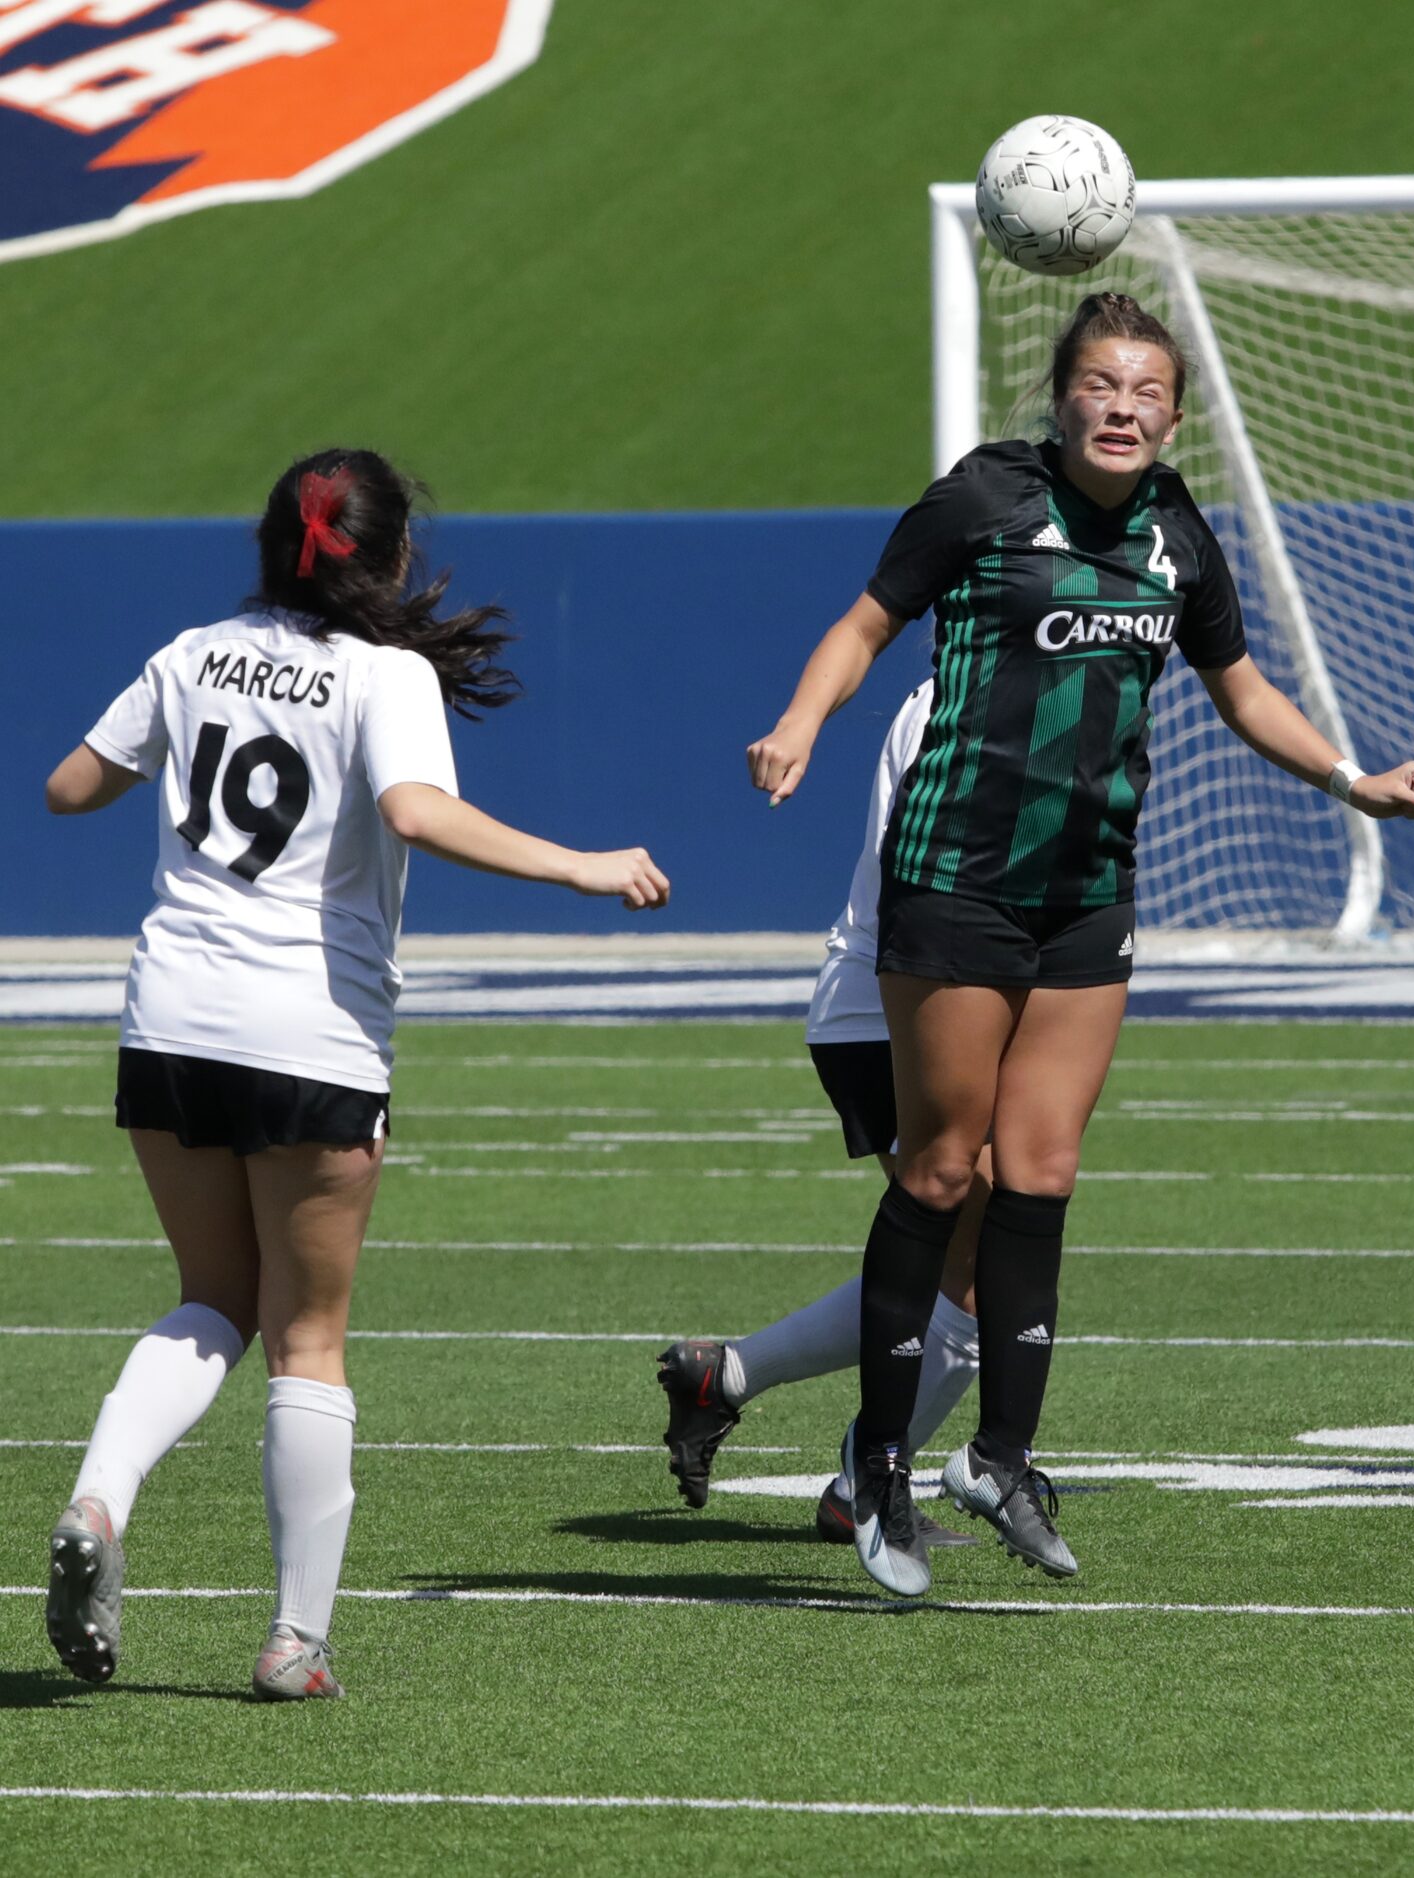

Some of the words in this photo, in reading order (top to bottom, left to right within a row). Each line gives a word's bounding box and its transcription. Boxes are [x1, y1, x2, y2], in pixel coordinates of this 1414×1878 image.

[1032, 538, 1070, 550] adidas
[1147, 525, 1178, 591] 4
[1034, 610, 1176, 650] CARROLL
[197, 651, 335, 708] MARCUS
[176, 721, 311, 884] 19
[891, 1348, 924, 1357] adidas
[1017, 1333, 1051, 1345] adidas
